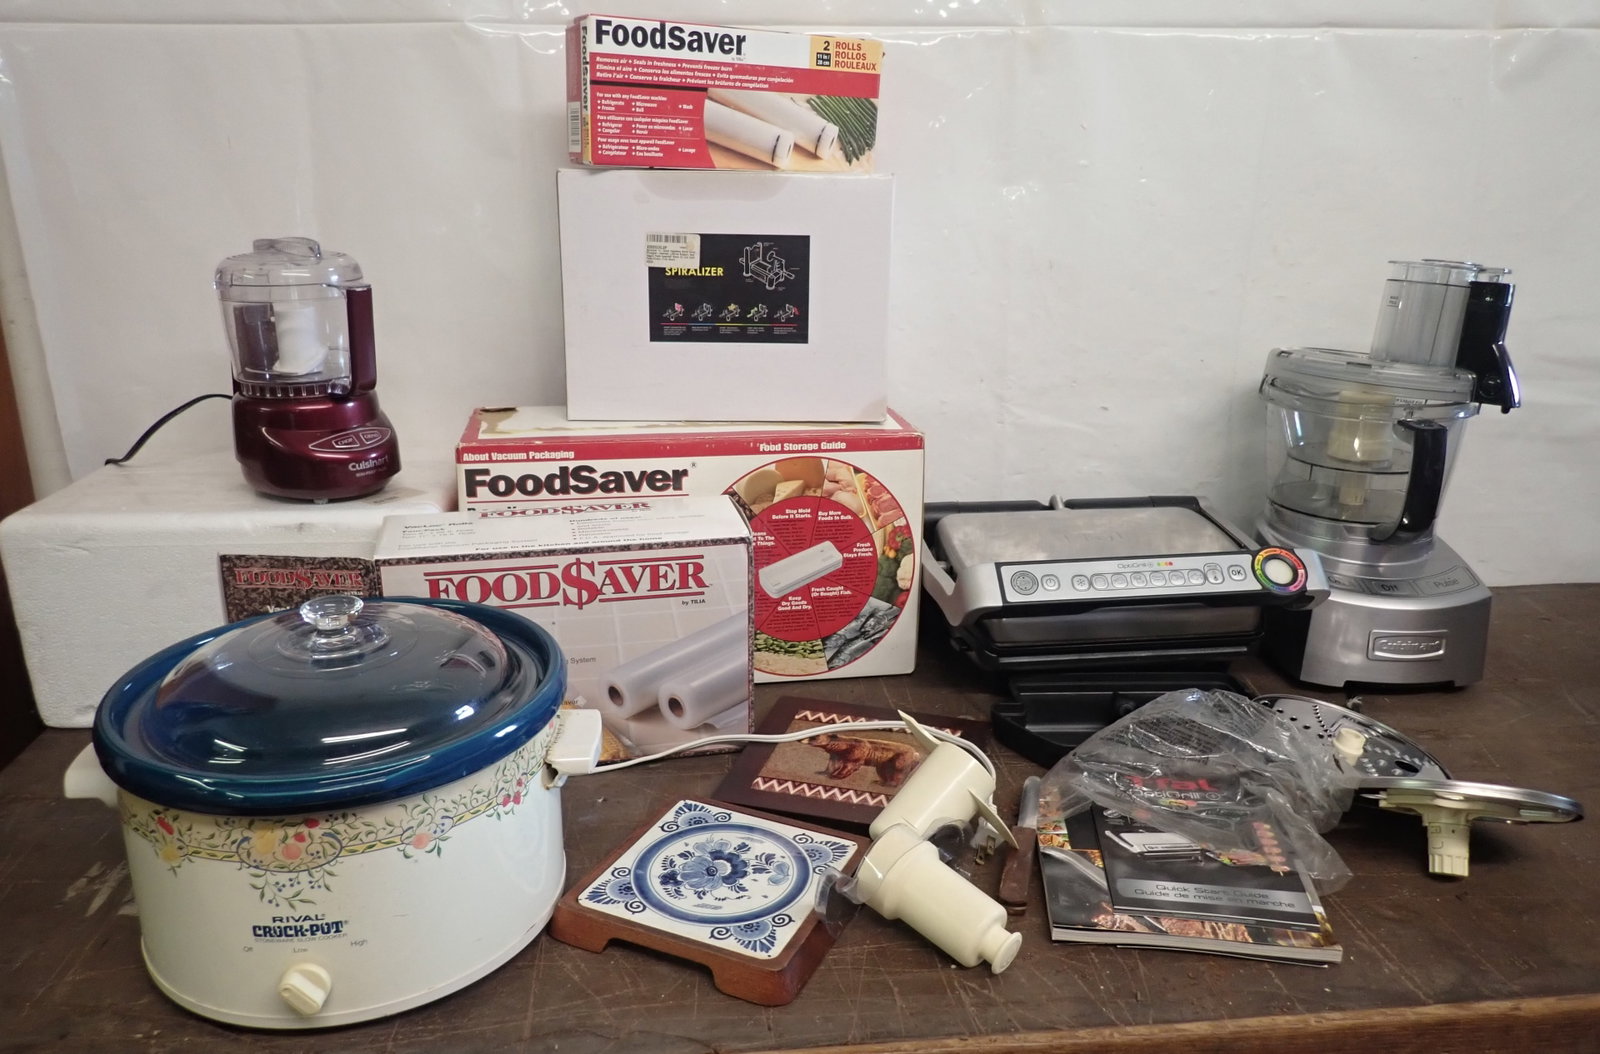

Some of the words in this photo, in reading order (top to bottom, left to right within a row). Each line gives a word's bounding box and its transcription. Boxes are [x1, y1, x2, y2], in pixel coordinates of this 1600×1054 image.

[595, 19, 746, 55] FoodSaver
[823, 41, 830, 51] 2
[836, 41, 862, 51] ROLLS
[835, 51, 867, 61] ROLLOS
[596, 56, 619, 64] Removes
[654, 60, 677, 68] freshness
[834, 60, 877, 71] ROULEAUX
[664, 267, 724, 277] SPIRALIZER
[760, 443, 781, 452] Food
[784, 442, 819, 451] Storage
[821, 441, 847, 450] Guide
[463, 452, 490, 461] About
[492, 452, 527, 461] Vacuum
[529, 450, 575, 460] Packaging
[348, 455, 389, 471] Cuisinart
[464, 465, 689, 498] FoodSaver
[1434, 578, 1459, 588] Pulse
[570, 656, 596, 665] System
[1156, 884, 1191, 893] Quick
[1194, 887, 1228, 897] Start
[1233, 890, 1269, 900] Guide
[1134, 888, 1170, 898] Guide
[1174, 891, 1189, 899] de
[1246, 899, 1296, 909] marche
[272, 914, 325, 924] RIVAL
[350, 938, 368, 947] High
